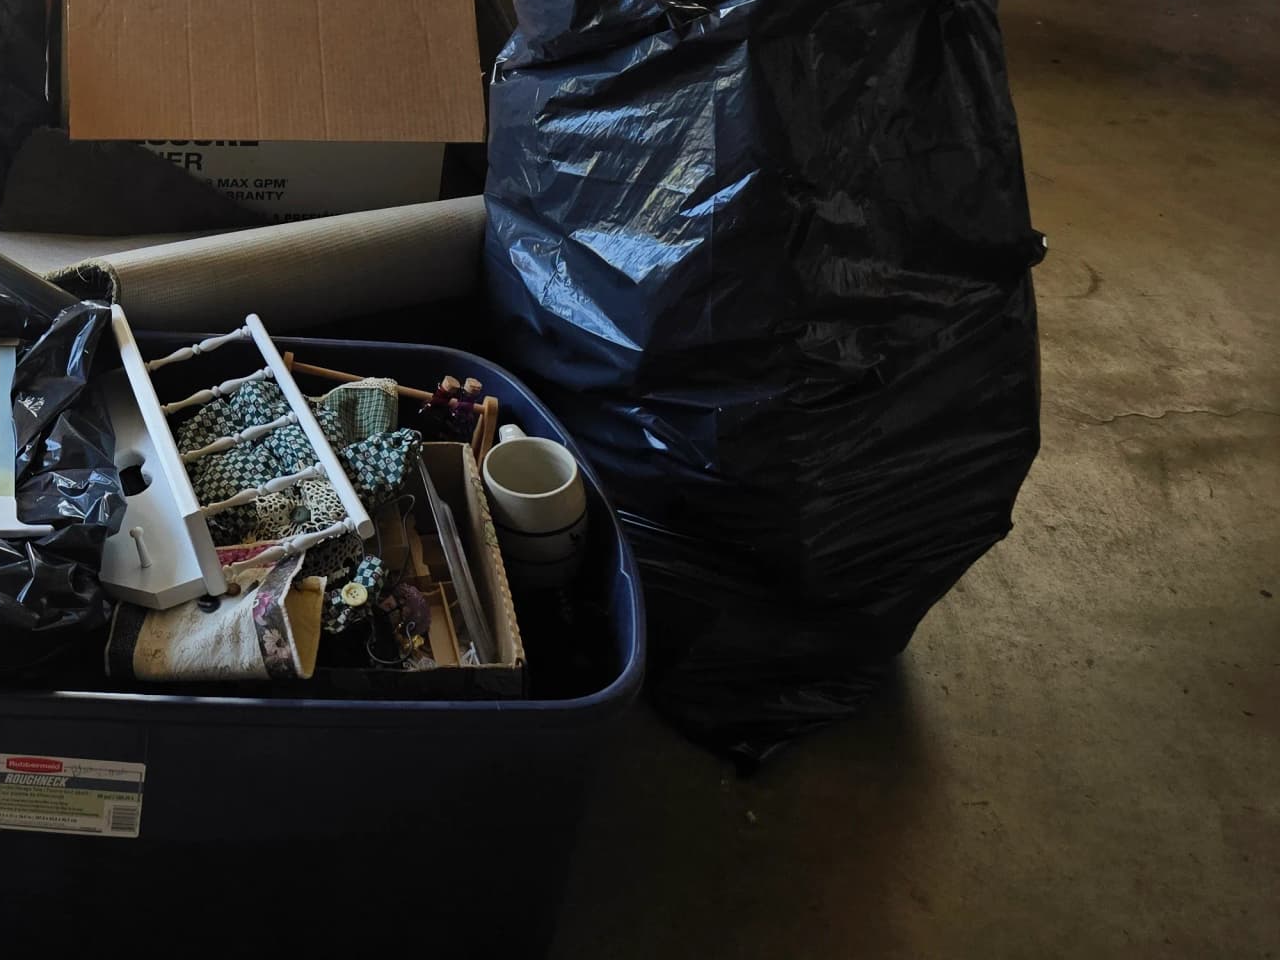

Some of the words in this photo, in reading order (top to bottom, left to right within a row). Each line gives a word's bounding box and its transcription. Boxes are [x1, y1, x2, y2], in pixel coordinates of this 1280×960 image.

[217, 178, 249, 188] MAX
[226, 191, 284, 201] RRANTY
[4, 773, 69, 787] ROUGHNECK
